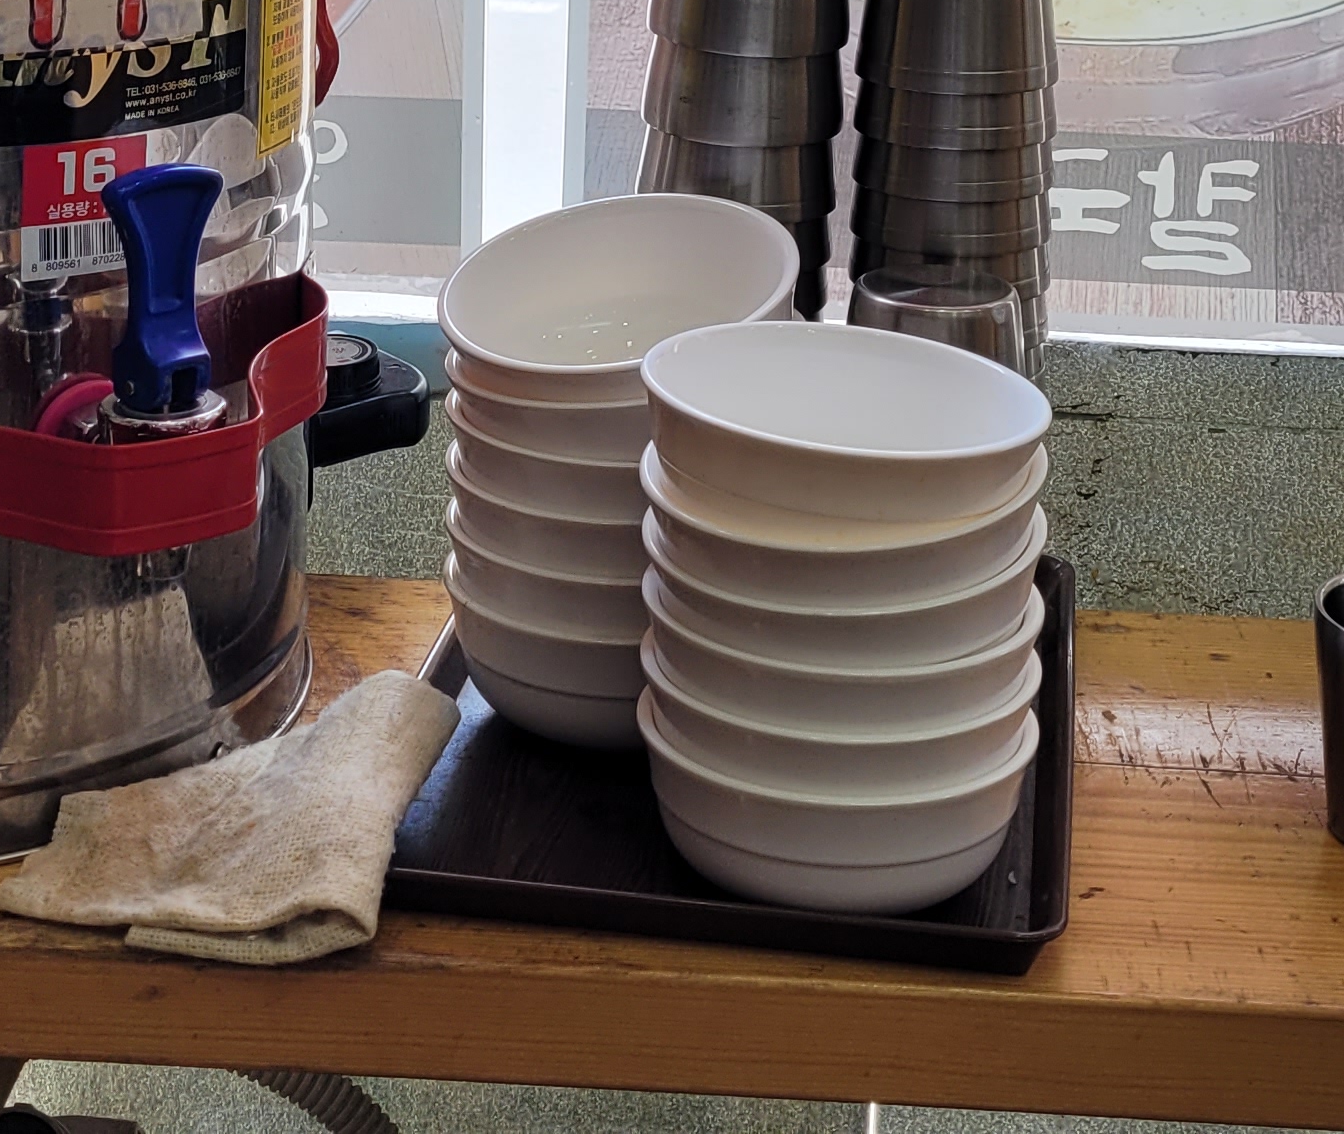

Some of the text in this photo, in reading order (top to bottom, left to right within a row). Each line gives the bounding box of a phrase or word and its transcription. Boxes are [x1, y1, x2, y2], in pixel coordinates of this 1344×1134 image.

[124, 105, 179, 120] MADE IN KOREA
[57, 147, 116, 196] 16
[31, 263, 38, 273] 8
[46, 259, 81, 271] 809561
